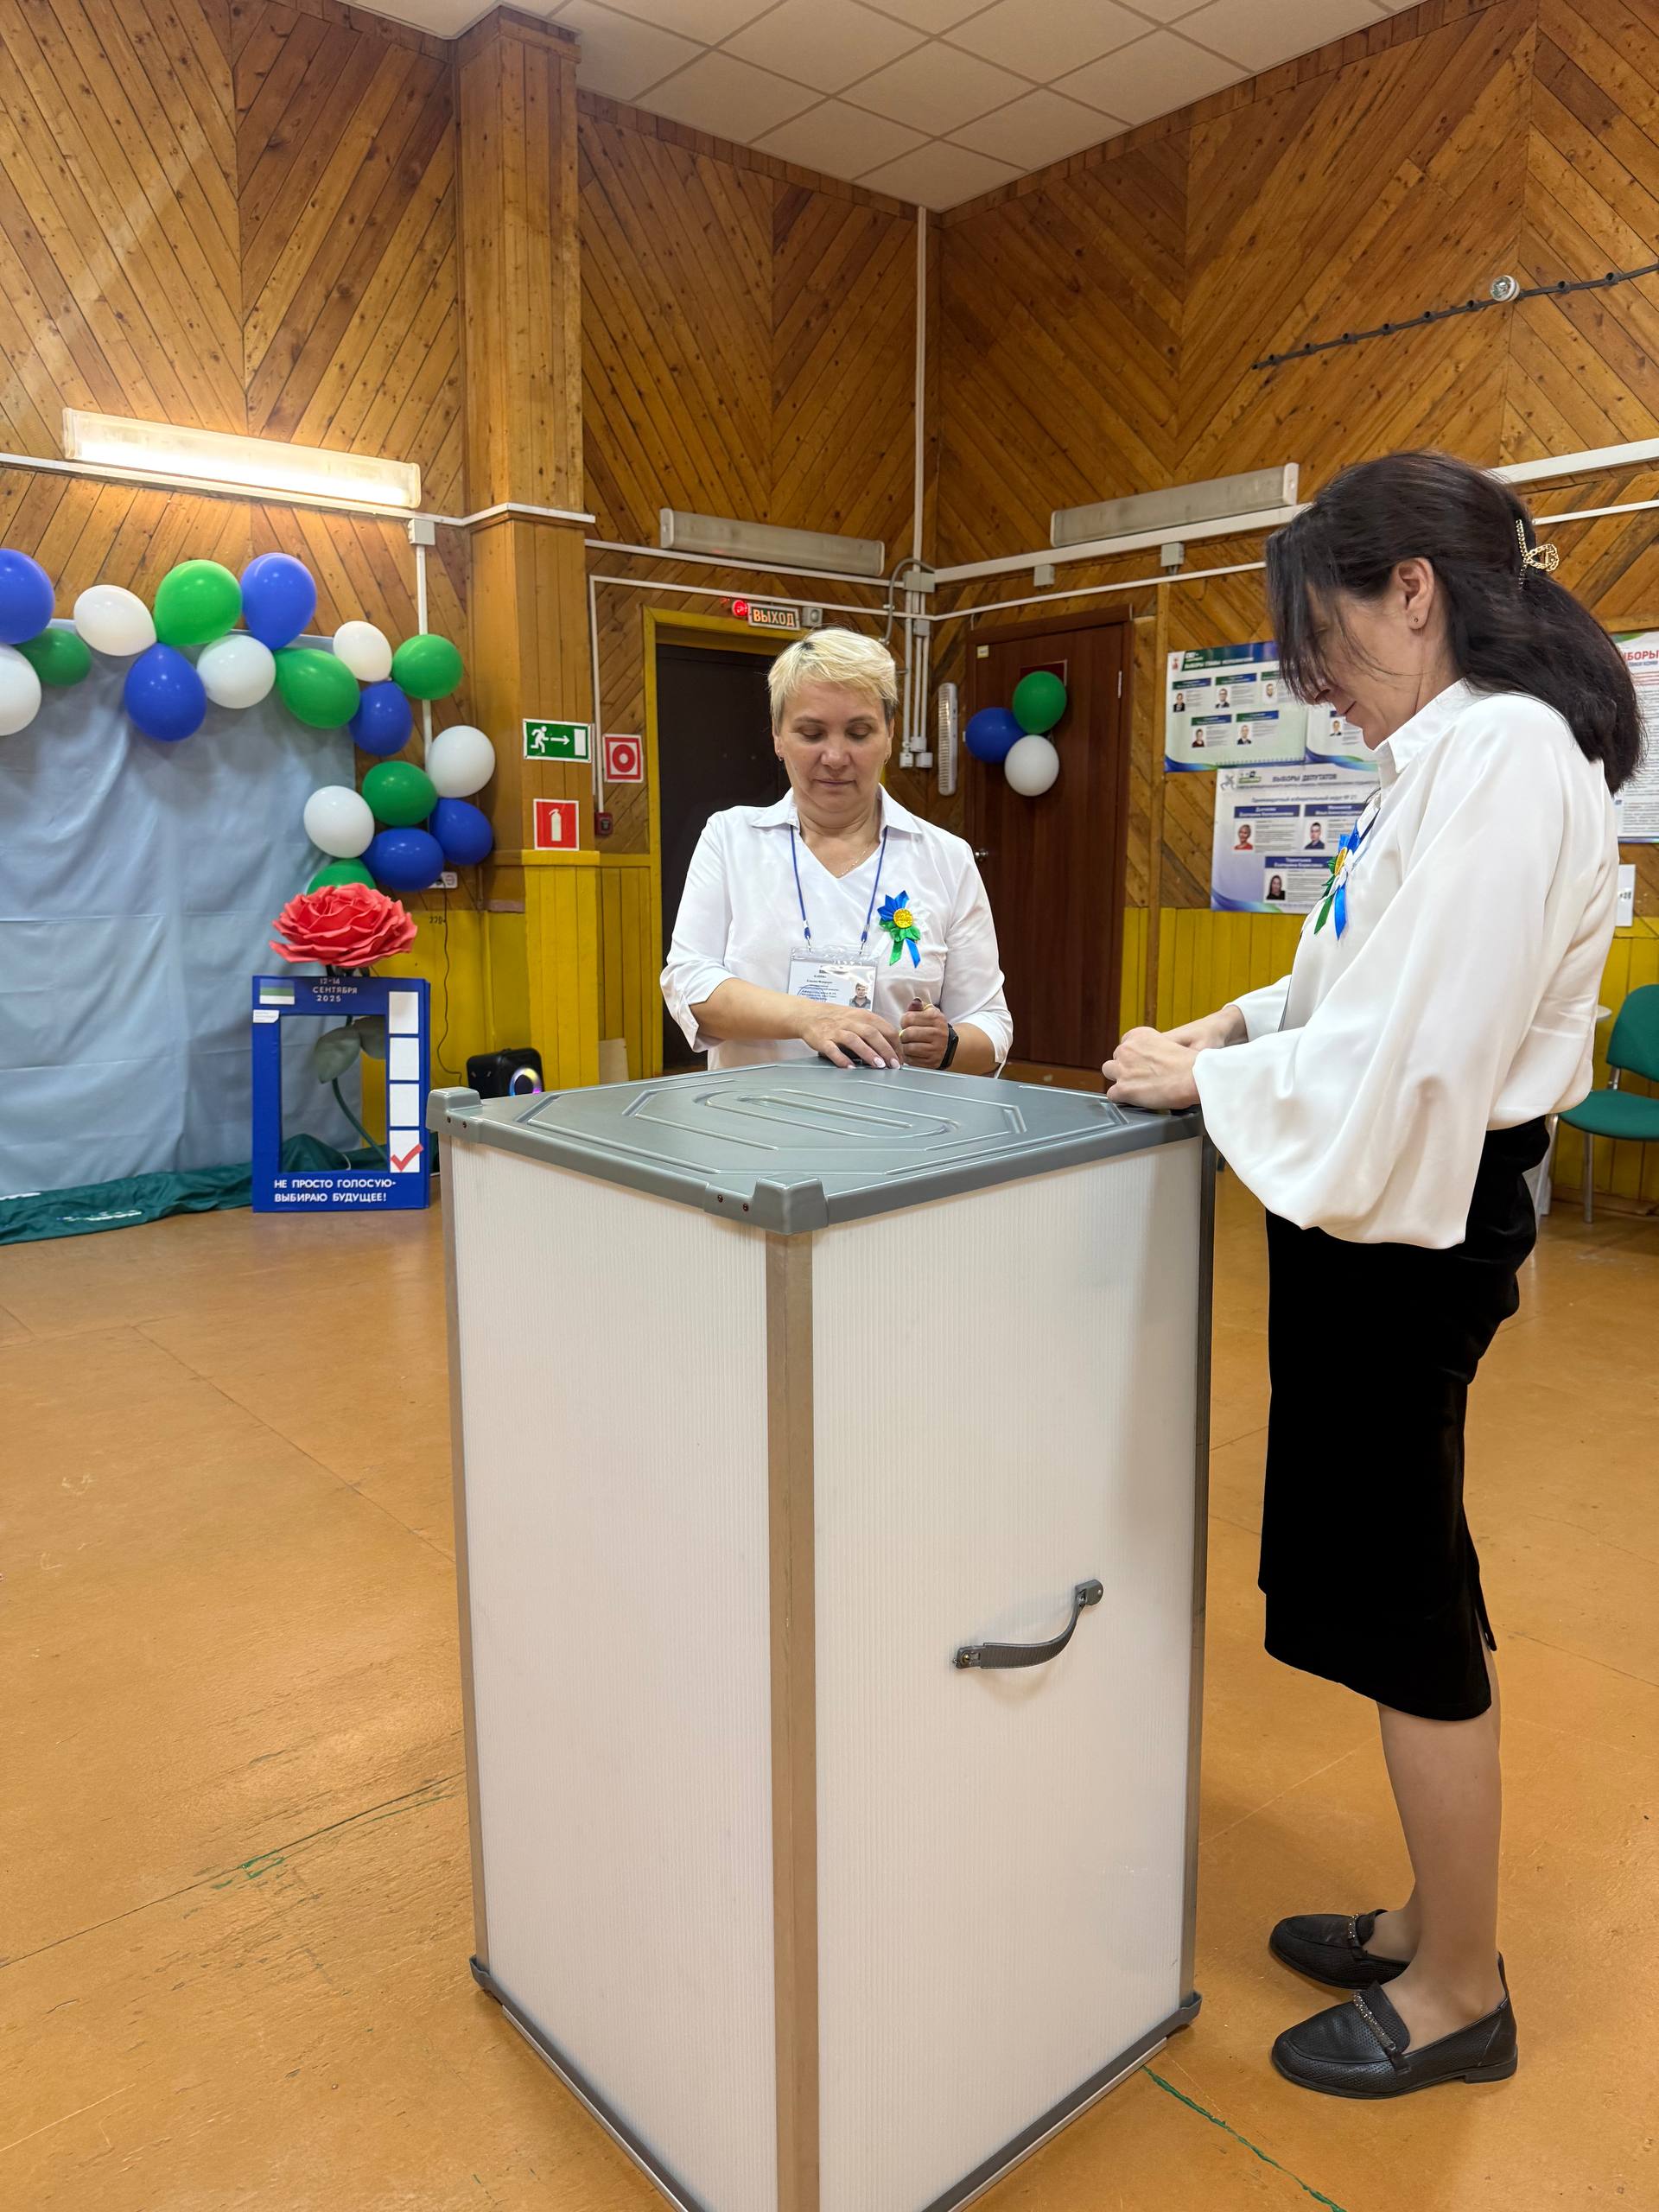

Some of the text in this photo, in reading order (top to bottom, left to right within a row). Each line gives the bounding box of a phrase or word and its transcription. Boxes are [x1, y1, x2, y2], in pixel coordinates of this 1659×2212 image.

[753, 608, 794, 626] ВЫХОД
[274, 1179, 287, 1189] НЕ
[291, 1179, 334, 1189] ПРОСТО
[274, 1192, 387, 1203] ВЫБИРАЮ БУДУЩЕЕ!
